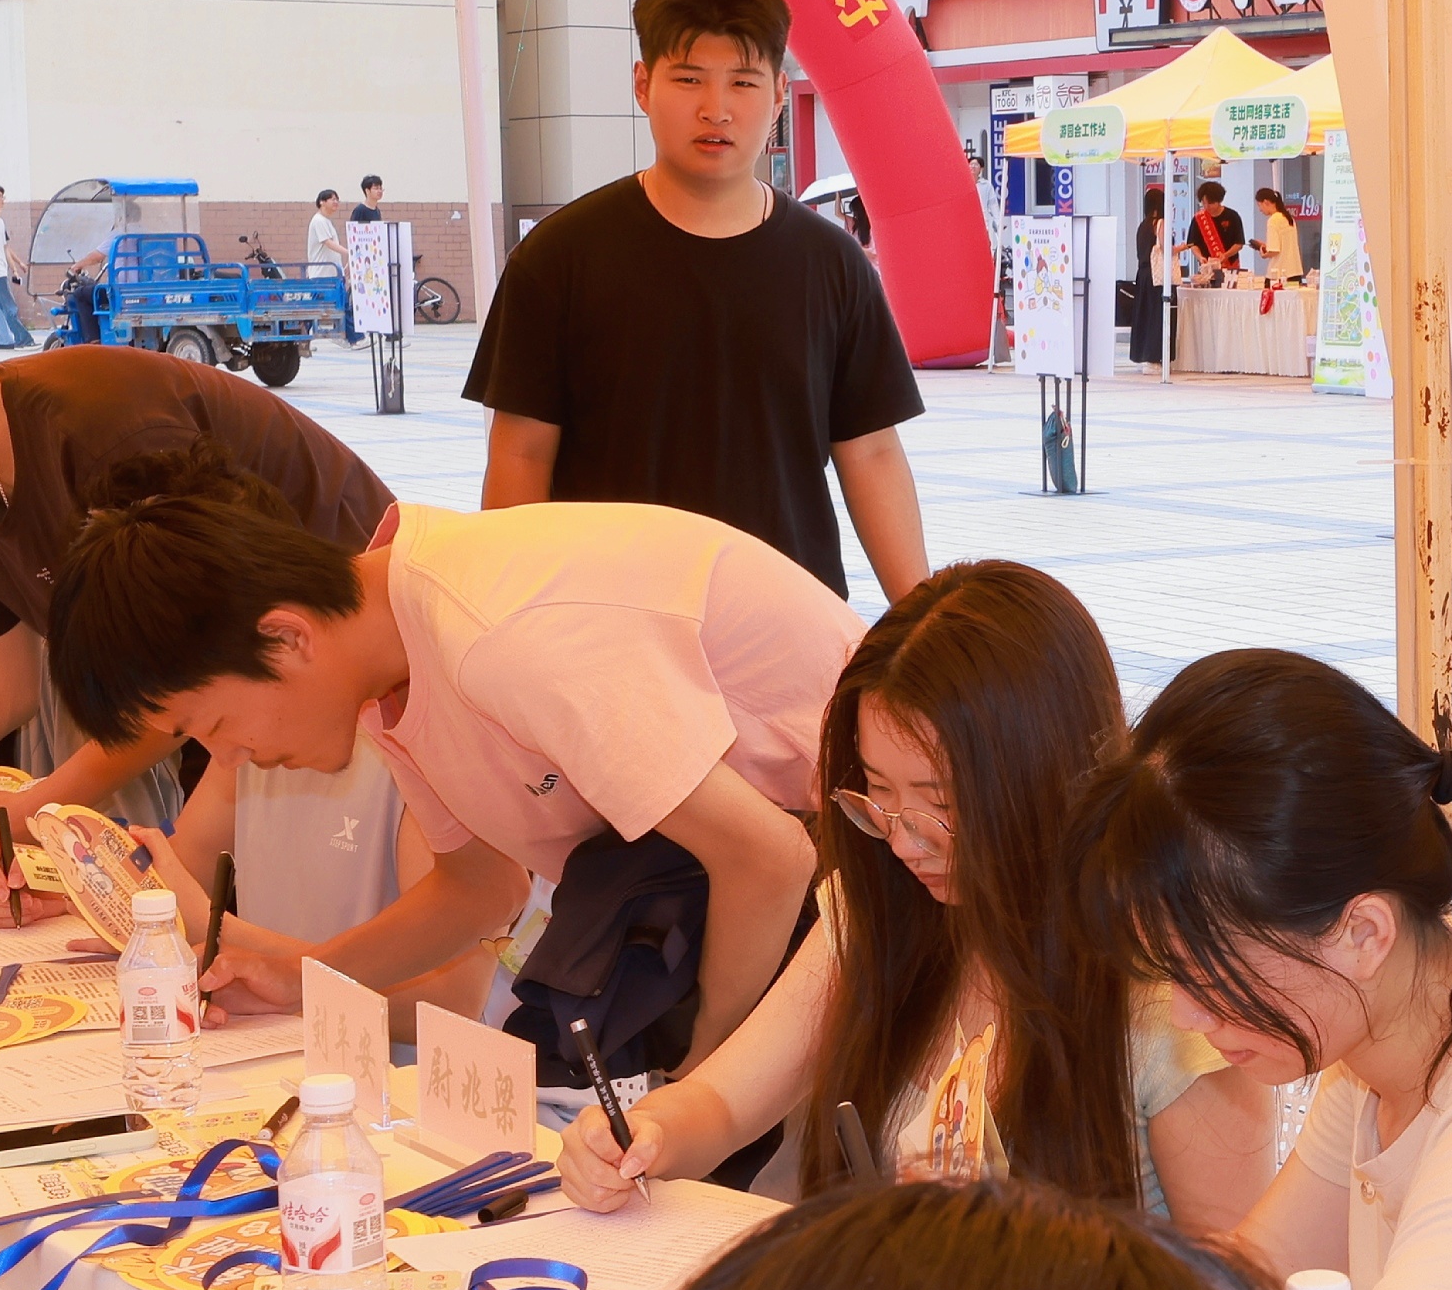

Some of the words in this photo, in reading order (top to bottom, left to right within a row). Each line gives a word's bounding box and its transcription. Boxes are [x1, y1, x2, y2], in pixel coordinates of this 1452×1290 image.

[1059, 122, 1107, 139] 游园会工作站
[1232, 123, 1287, 141] 户外游园活动
[282, 1201, 328, 1224] 娃哈哈
